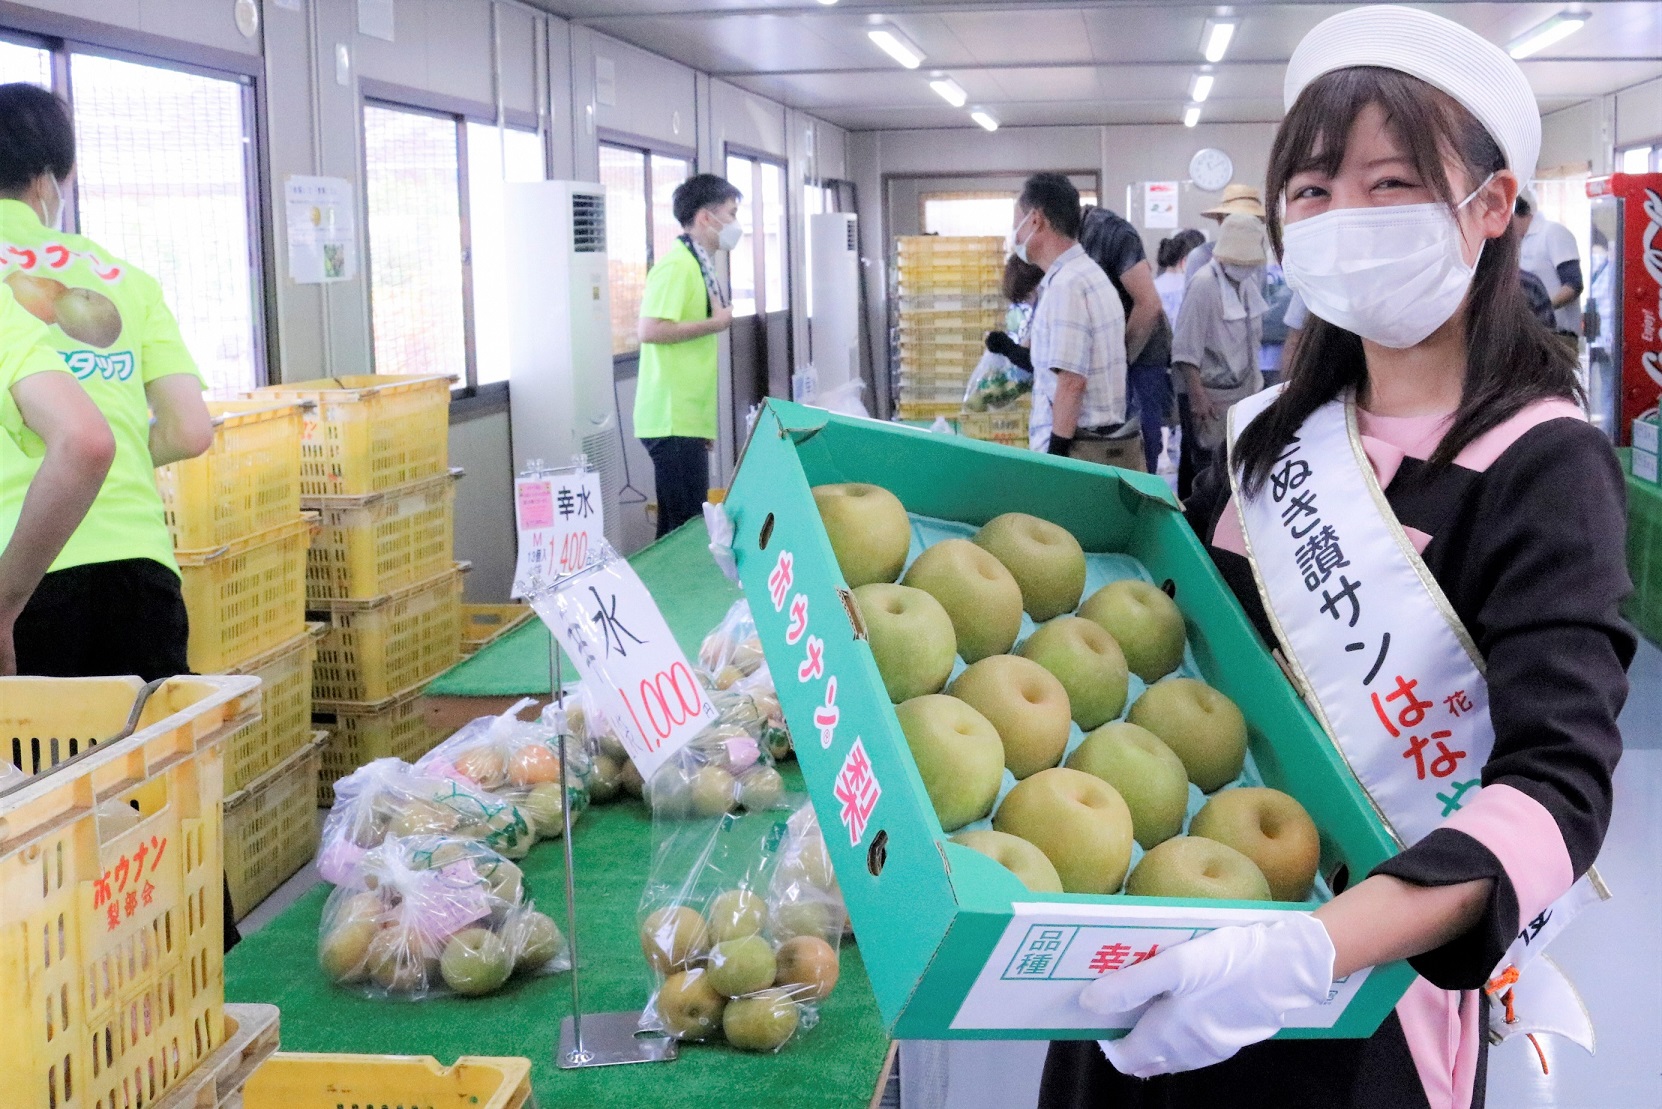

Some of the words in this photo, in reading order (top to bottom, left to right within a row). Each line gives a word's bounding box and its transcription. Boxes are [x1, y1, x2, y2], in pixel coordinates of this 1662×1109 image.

[57, 350, 134, 381] タッフ
[557, 485, 594, 521] 幸水
[533, 532, 542, 547] M
[548, 530, 588, 576] 1,400
[1270, 446, 1391, 686] ぬき讃サン
[619, 661, 702, 753] 1,000
[1442, 690, 1473, 717] 花
[93, 835, 167, 910] ホウナン
[1016, 930, 1063, 975] 品種
